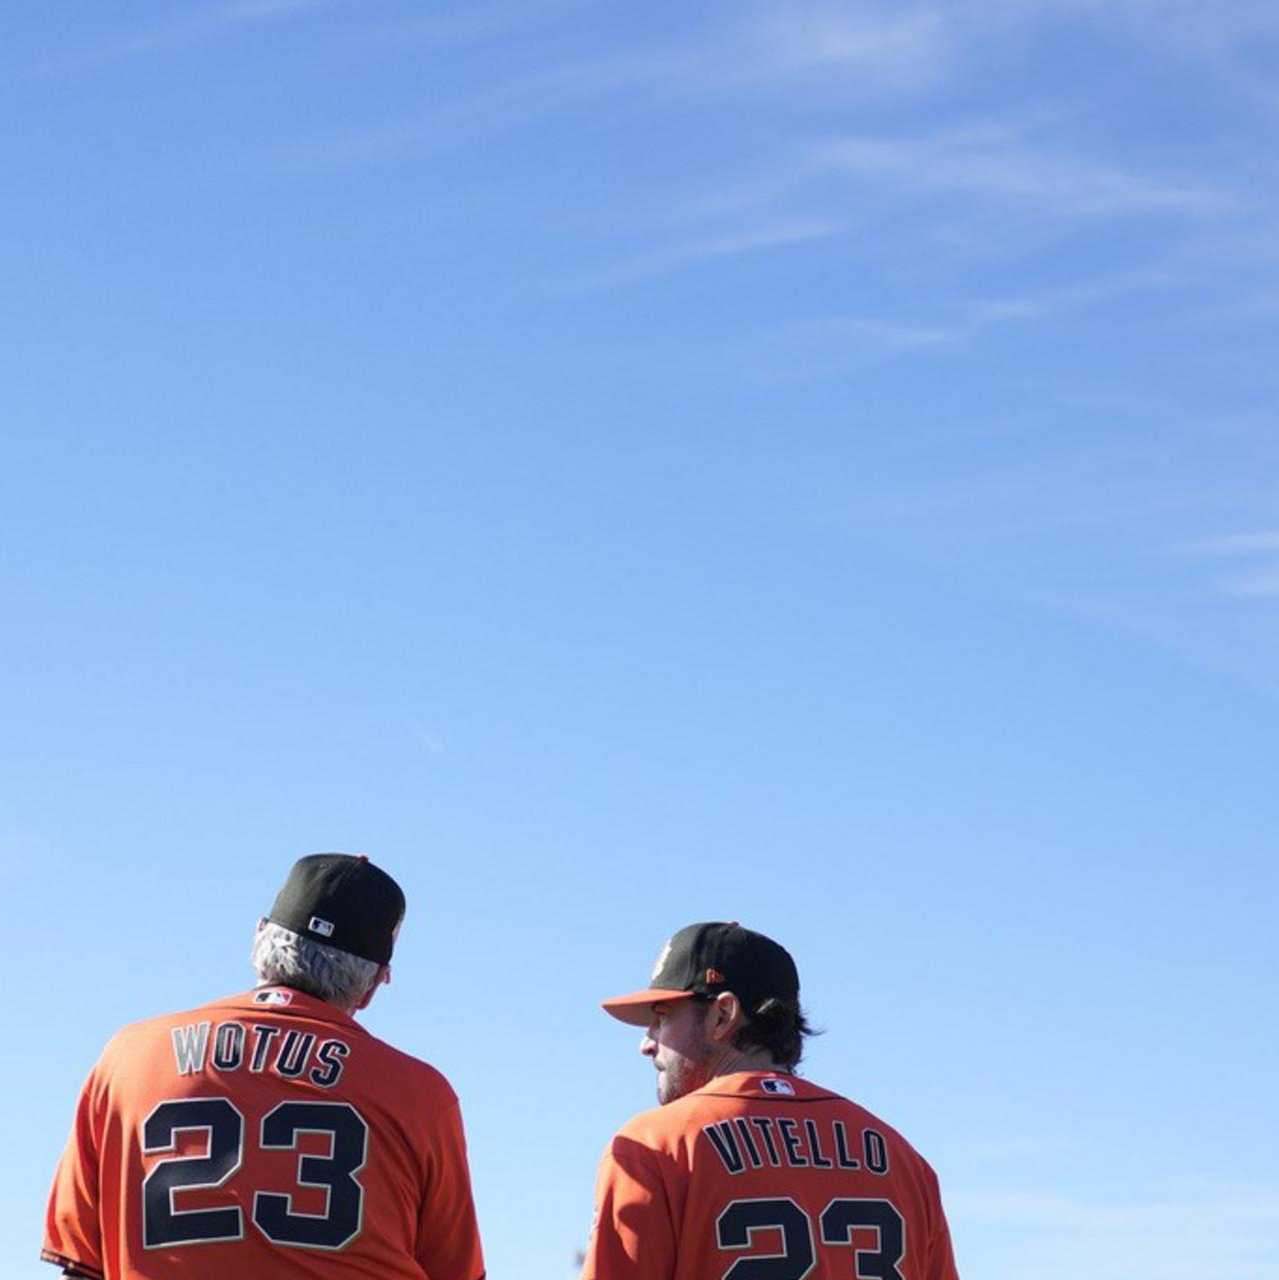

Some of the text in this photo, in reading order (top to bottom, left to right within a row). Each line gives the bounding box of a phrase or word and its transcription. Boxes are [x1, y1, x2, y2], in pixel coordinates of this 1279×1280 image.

[171, 1021, 351, 1090] WOTUS
[142, 1096, 369, 1253] 23
[704, 1116, 889, 1175] VITELLO
